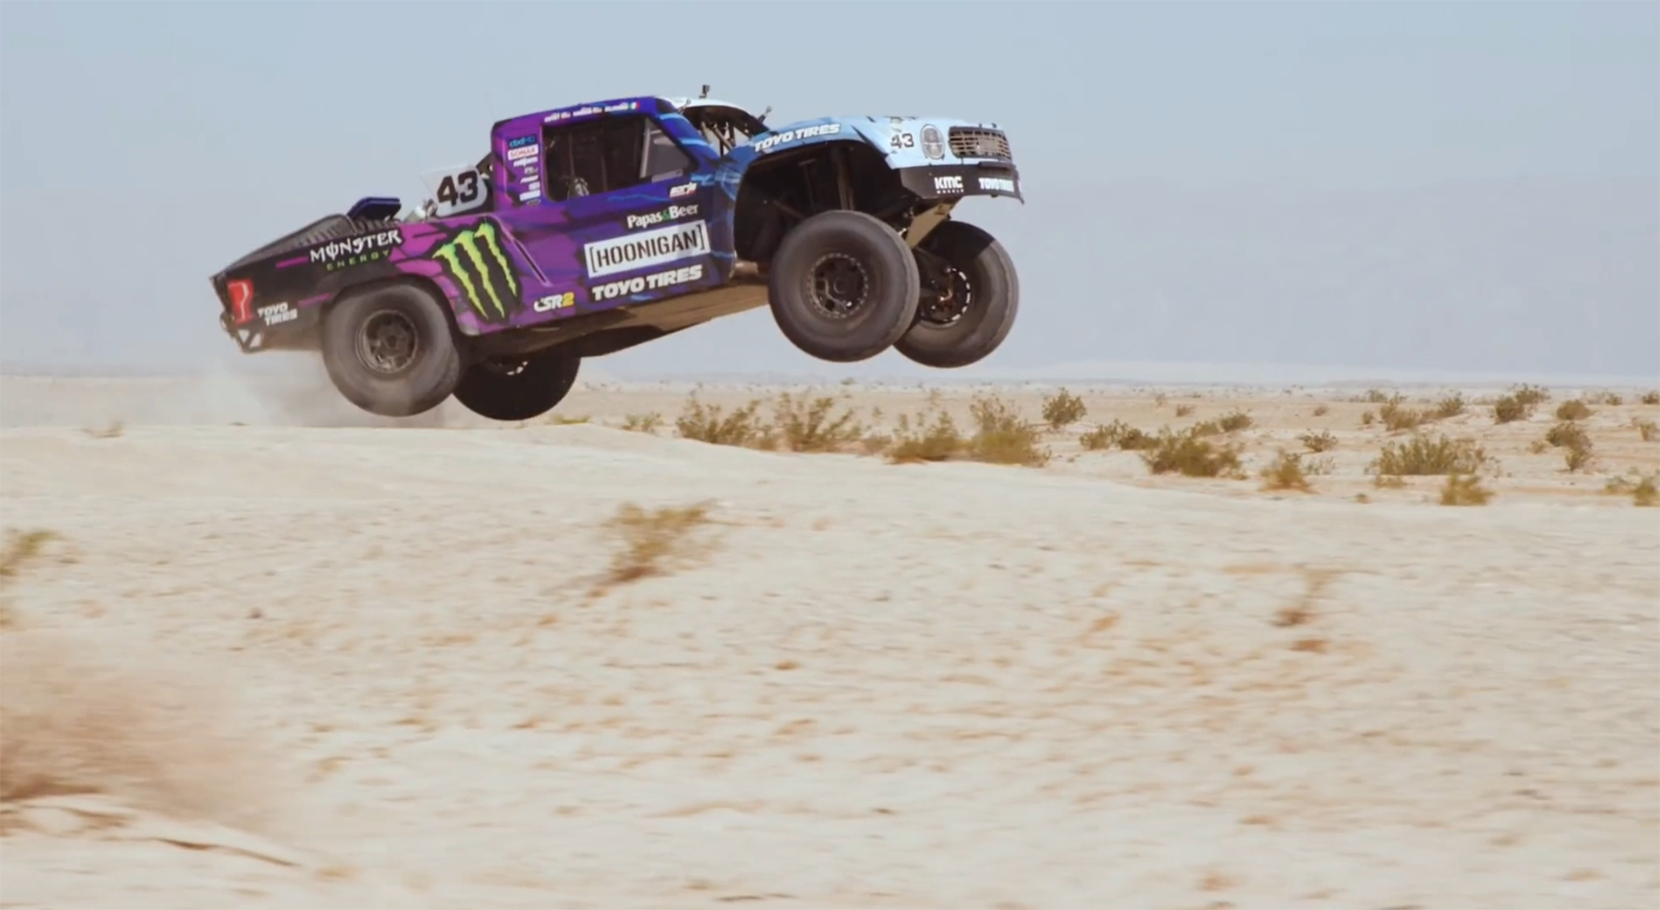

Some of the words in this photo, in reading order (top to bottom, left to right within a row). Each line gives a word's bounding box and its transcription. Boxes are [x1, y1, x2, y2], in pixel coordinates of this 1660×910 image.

[754, 131, 794, 152] TOYO
[794, 123, 841, 140] TIRES
[890, 133, 914, 149] 43
[436, 169, 478, 207] 43
[934, 176, 963, 190] KMC
[592, 277, 645, 301] TOYO
[645, 264, 703, 289] TIRES
[257, 302, 289, 317] TOYO
[264, 308, 298, 326] TIRES
